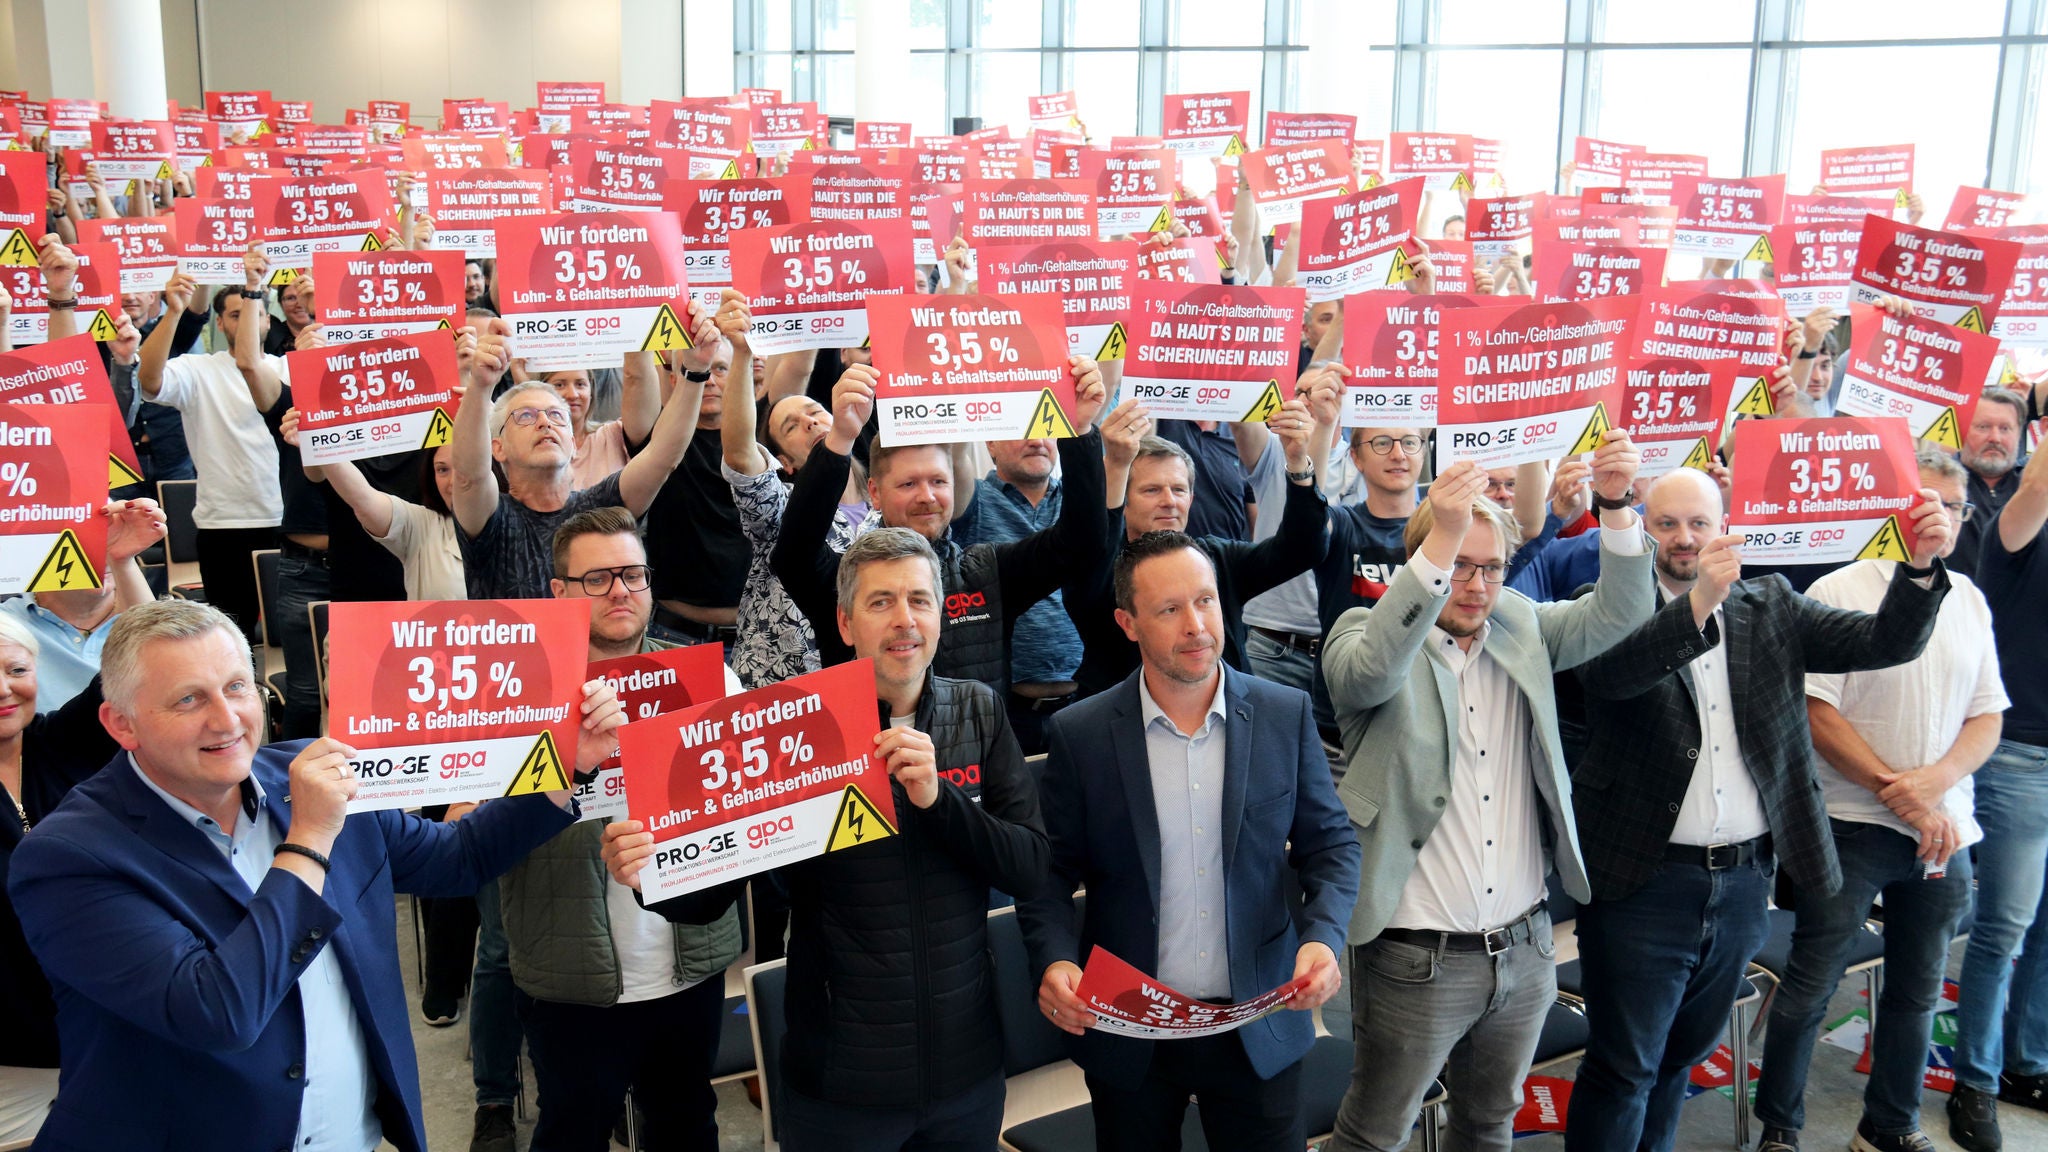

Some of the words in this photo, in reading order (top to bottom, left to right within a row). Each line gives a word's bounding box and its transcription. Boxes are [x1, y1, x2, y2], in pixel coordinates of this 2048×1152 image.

[224, 104, 244, 116] 3,5
[1183, 99, 1198, 108] Wir
[1200, 98, 1232, 108] fordern
[674, 109, 693, 121] Wir
[695, 112, 731, 125] fordern
[762, 108, 775, 117] Wir
[776, 107, 804, 116] fordern
[1187, 110, 1211, 127] 3,5
[1215, 111, 1226, 124] %
[463, 115, 482, 128] 3,5
[766, 117, 788, 132] 3,5
[790, 118, 800, 129] %
[108, 127, 122, 135] Wir
[124, 127, 156, 135] fordern
[712, 130, 724, 144] %
[114, 137, 139, 152] 3,5
[141, 138, 154, 150] %
[425, 144, 444, 152] Wir
[446, 144, 484, 152] fordern
[1408, 137, 1421, 145] Wir
[1422, 137, 1456, 146] fordern
[595, 151, 615, 163] Wir
[618, 153, 662, 167] fordern
[919, 154, 935, 164] Wir
[936, 155, 965, 164] fordern
[1266, 154, 1284, 167] Wir
[1286, 148, 1325, 163] fordern
[1413, 147, 1437, 163] 3,5
[1440, 150, 1452, 161] %
[1106, 159, 1125, 171] Wir
[1127, 158, 1161, 170] fordern
[1310, 163, 1325, 178] %
[601, 166, 634, 190] 3,5
[282, 186, 305, 198] Wir
[309, 183, 357, 196] fordern
[442, 195, 458, 204] DA
[501, 194, 519, 204] DIR
[522, 194, 539, 204] DIE
[699, 189, 725, 202] Wir
[728, 189, 782, 202] fordern
[853, 191, 874, 203] DIR
[876, 192, 896, 203] DIE
[1698, 183, 1718, 195] Wir
[1720, 185, 1763, 199] fordern
[204, 206, 226, 219] Wir
[292, 200, 329, 224] 3,5
[704, 207, 746, 233] 3,5
[867, 208, 902, 219] RAUS!
[979, 208, 996, 219] DA
[1043, 208, 1063, 219] DIR
[1065, 208, 1084, 219] DIE
[102, 225, 122, 236] Wir
[124, 224, 167, 234] fordern
[212, 220, 247, 245] 3,5
[264, 227, 290, 236] Lohn-
[540, 227, 574, 245] Wir
[580, 226, 648, 244] fordern
[972, 225, 1053, 237] SICHERUNGEN
[1056, 225, 1091, 237] RAUS!
[1340, 216, 1372, 247] 3,5
[1559, 227, 1579, 239] Wir
[1582, 227, 1621, 238] fordern
[1795, 231, 1816, 244] Wir
[770, 236, 802, 254] Wir
[807, 233, 873, 251] fordern
[1308, 253, 1336, 265] Lohn-
[1599, 256, 1640, 269] fordern
[1802, 246, 1838, 272] 3,5
[348, 261, 374, 275] Wir
[378, 262, 433, 275] fordern
[554, 250, 607, 288] 3,5
[784, 257, 833, 292] 3,5
[1895, 253, 1942, 284] 3,5
[1074, 278, 1098, 291] DIR
[1101, 276, 1123, 290] DIE
[1436, 281, 1466, 292] RAUS!
[1576, 271, 1612, 298] 3,5
[358, 279, 400, 307] 3,5
[513, 291, 552, 304] Lohn-
[556, 290, 566, 302] &
[569, 284, 680, 301] Gehaltserhöhung!
[785, 294, 794, 305] &
[326, 308, 356, 319] Lohn-
[358, 308, 366, 317] &
[369, 304, 456, 317] Gehaltserhöhung!
[910, 307, 944, 328] Wir
[950, 308, 1022, 326] fordern
[1155, 300, 1167, 314] %
[1170, 302, 1295, 321] Lohn-/Gehaltserhöhung:
[1150, 321, 1173, 338] DA
[1234, 326, 1259, 342] DIR
[1486, 319, 1626, 345] Lohn-/Gehaltserhöhung:
[1731, 331, 1753, 344] DIR
[1756, 333, 1775, 346] DIE
[326, 356, 355, 372] Wir
[359, 347, 420, 367] fordern
[926, 332, 983, 371] 3,5
[1138, 345, 1244, 366] SICHERUNGEN
[1247, 350, 1288, 367] RAUS!
[1464, 356, 1491, 376] DA
[1561, 344, 1587, 366] DIR
[1591, 341, 1614, 362] DIE
[1881, 339, 1920, 373] 3,5
[932, 372, 943, 385] &
[946, 367, 1062, 386] Gehaltserhöhung!
[1355, 366, 1391, 378] Lohn-
[1658, 370, 1711, 386] fordern
[339, 370, 385, 403] 3,5
[1452, 377, 1571, 405] SICHERUNGEN
[1575, 367, 1616, 393] RAUS!
[1196, 387, 1230, 405] gpa
[307, 410, 340, 422] Lohn-
[343, 406, 352, 417] &
[1632, 391, 1674, 423] 3,5
[1522, 421, 1558, 444] gpa
[1780, 433, 1812, 453] Wir
[1816, 431, 1880, 451] fordern
[1790, 458, 1842, 498] 3,5
[1744, 501, 1783, 514] Lohn-
[1787, 501, 1797, 513] &
[1801, 495, 1913, 512] Gehaltserhöhung!
[945, 591, 986, 618] gpa
[392, 622, 440, 648] Wir
[444, 619, 536, 646] fordern
[407, 655, 478, 710] 3,5
[489, 661, 522, 698] %
[348, 714, 401, 735] Lohn-
[425, 703, 570, 730] Gehaltserhöhung!
[679, 722, 724, 749] Wir
[730, 692, 822, 735] fordern
[700, 737, 770, 793] 3,5
[779, 731, 814, 767] %
[703, 795, 718, 815] &
[722, 753, 870, 810] Gehaltserhöhung!
[747, 816, 794, 849] gpa
[659, 870, 667, 878] DIE
